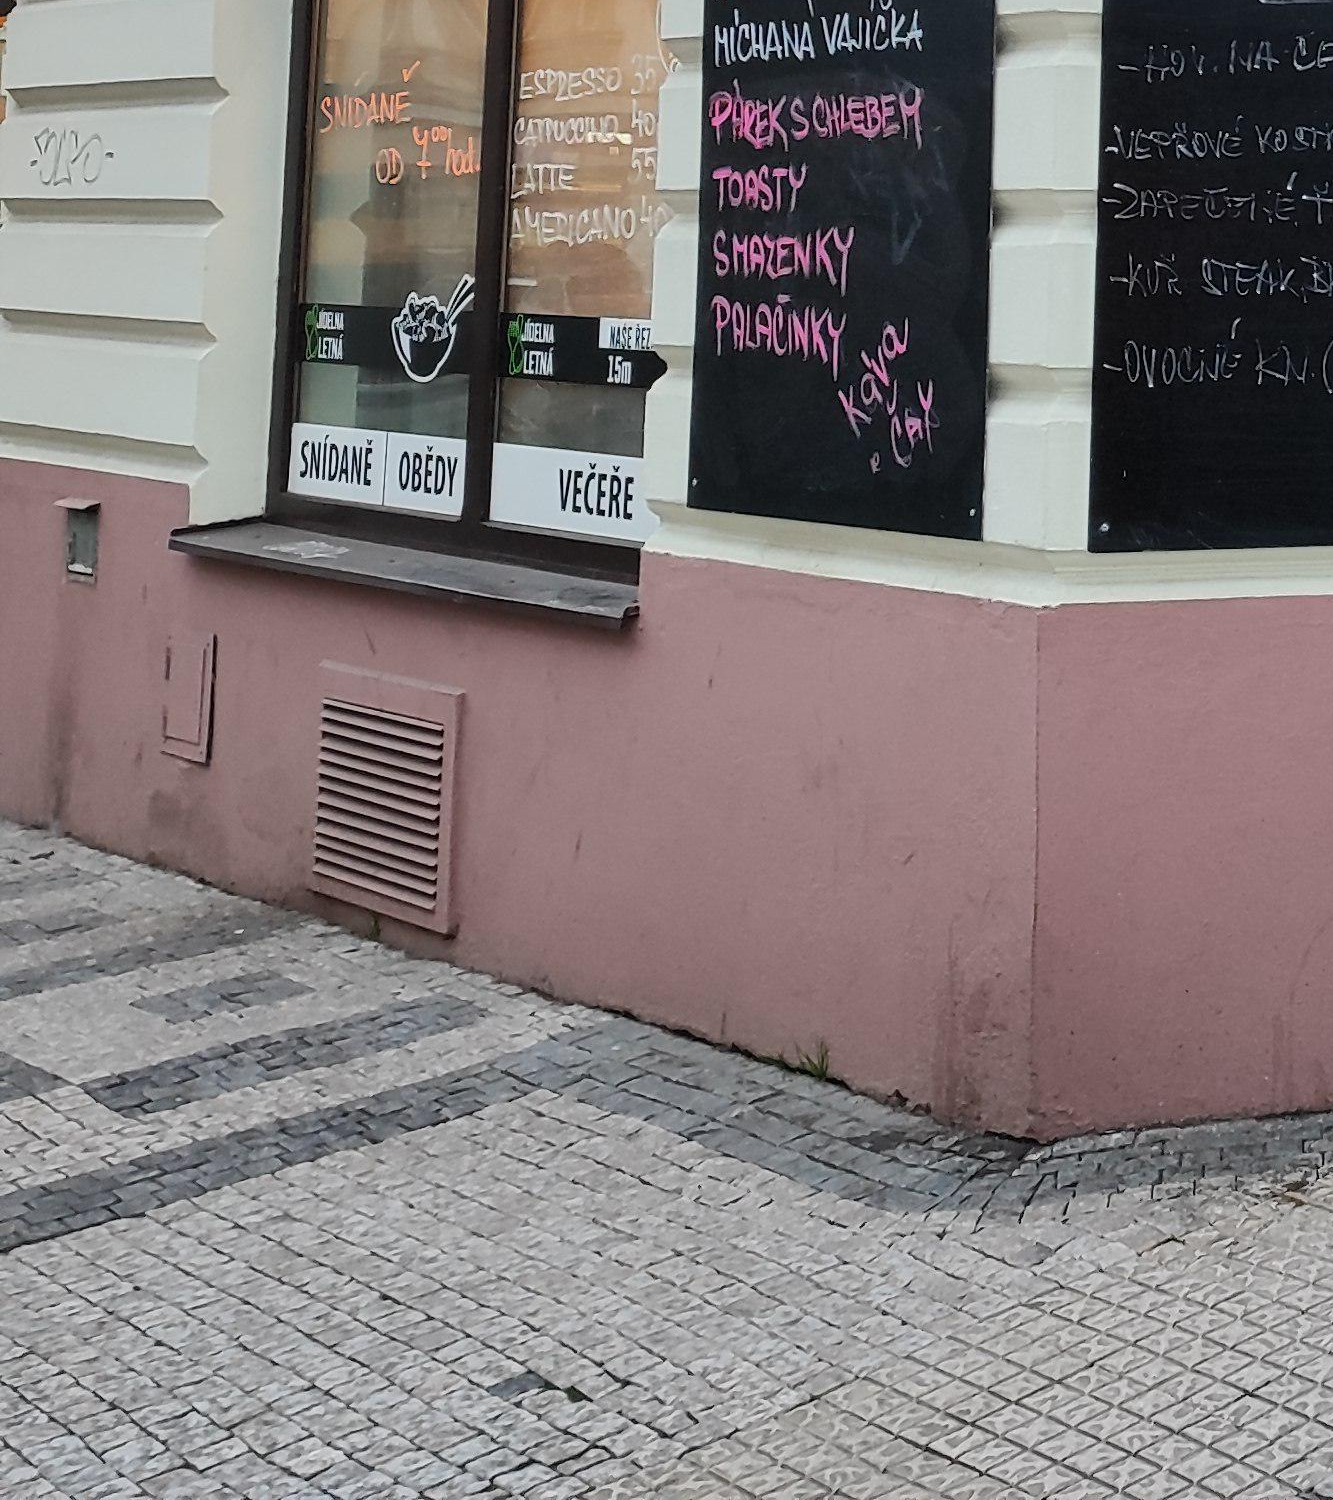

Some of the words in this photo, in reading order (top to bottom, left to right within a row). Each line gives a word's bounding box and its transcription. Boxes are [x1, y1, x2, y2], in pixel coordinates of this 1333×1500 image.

[1230, 39, 1279, 74] NA
[519, 67, 622, 101] ESPRESSO
[375, 147, 404, 184] OD
[510, 163, 579, 199] LATTE
[713, 162, 808, 213] TOASTY
[316, 310, 343, 331] JÍDELNA
[521, 317, 555, 344] JÍDELNA
[710, 293, 848, 381] PALAČINKY
[318, 336, 343, 361] LETNÁ
[523, 347, 554, 377] LETNÁ
[299, 434, 372, 487] SNÍDANĚ
[399, 445, 459, 498] OBĚDY
[559, 462, 635, 521] VEČEŘE
